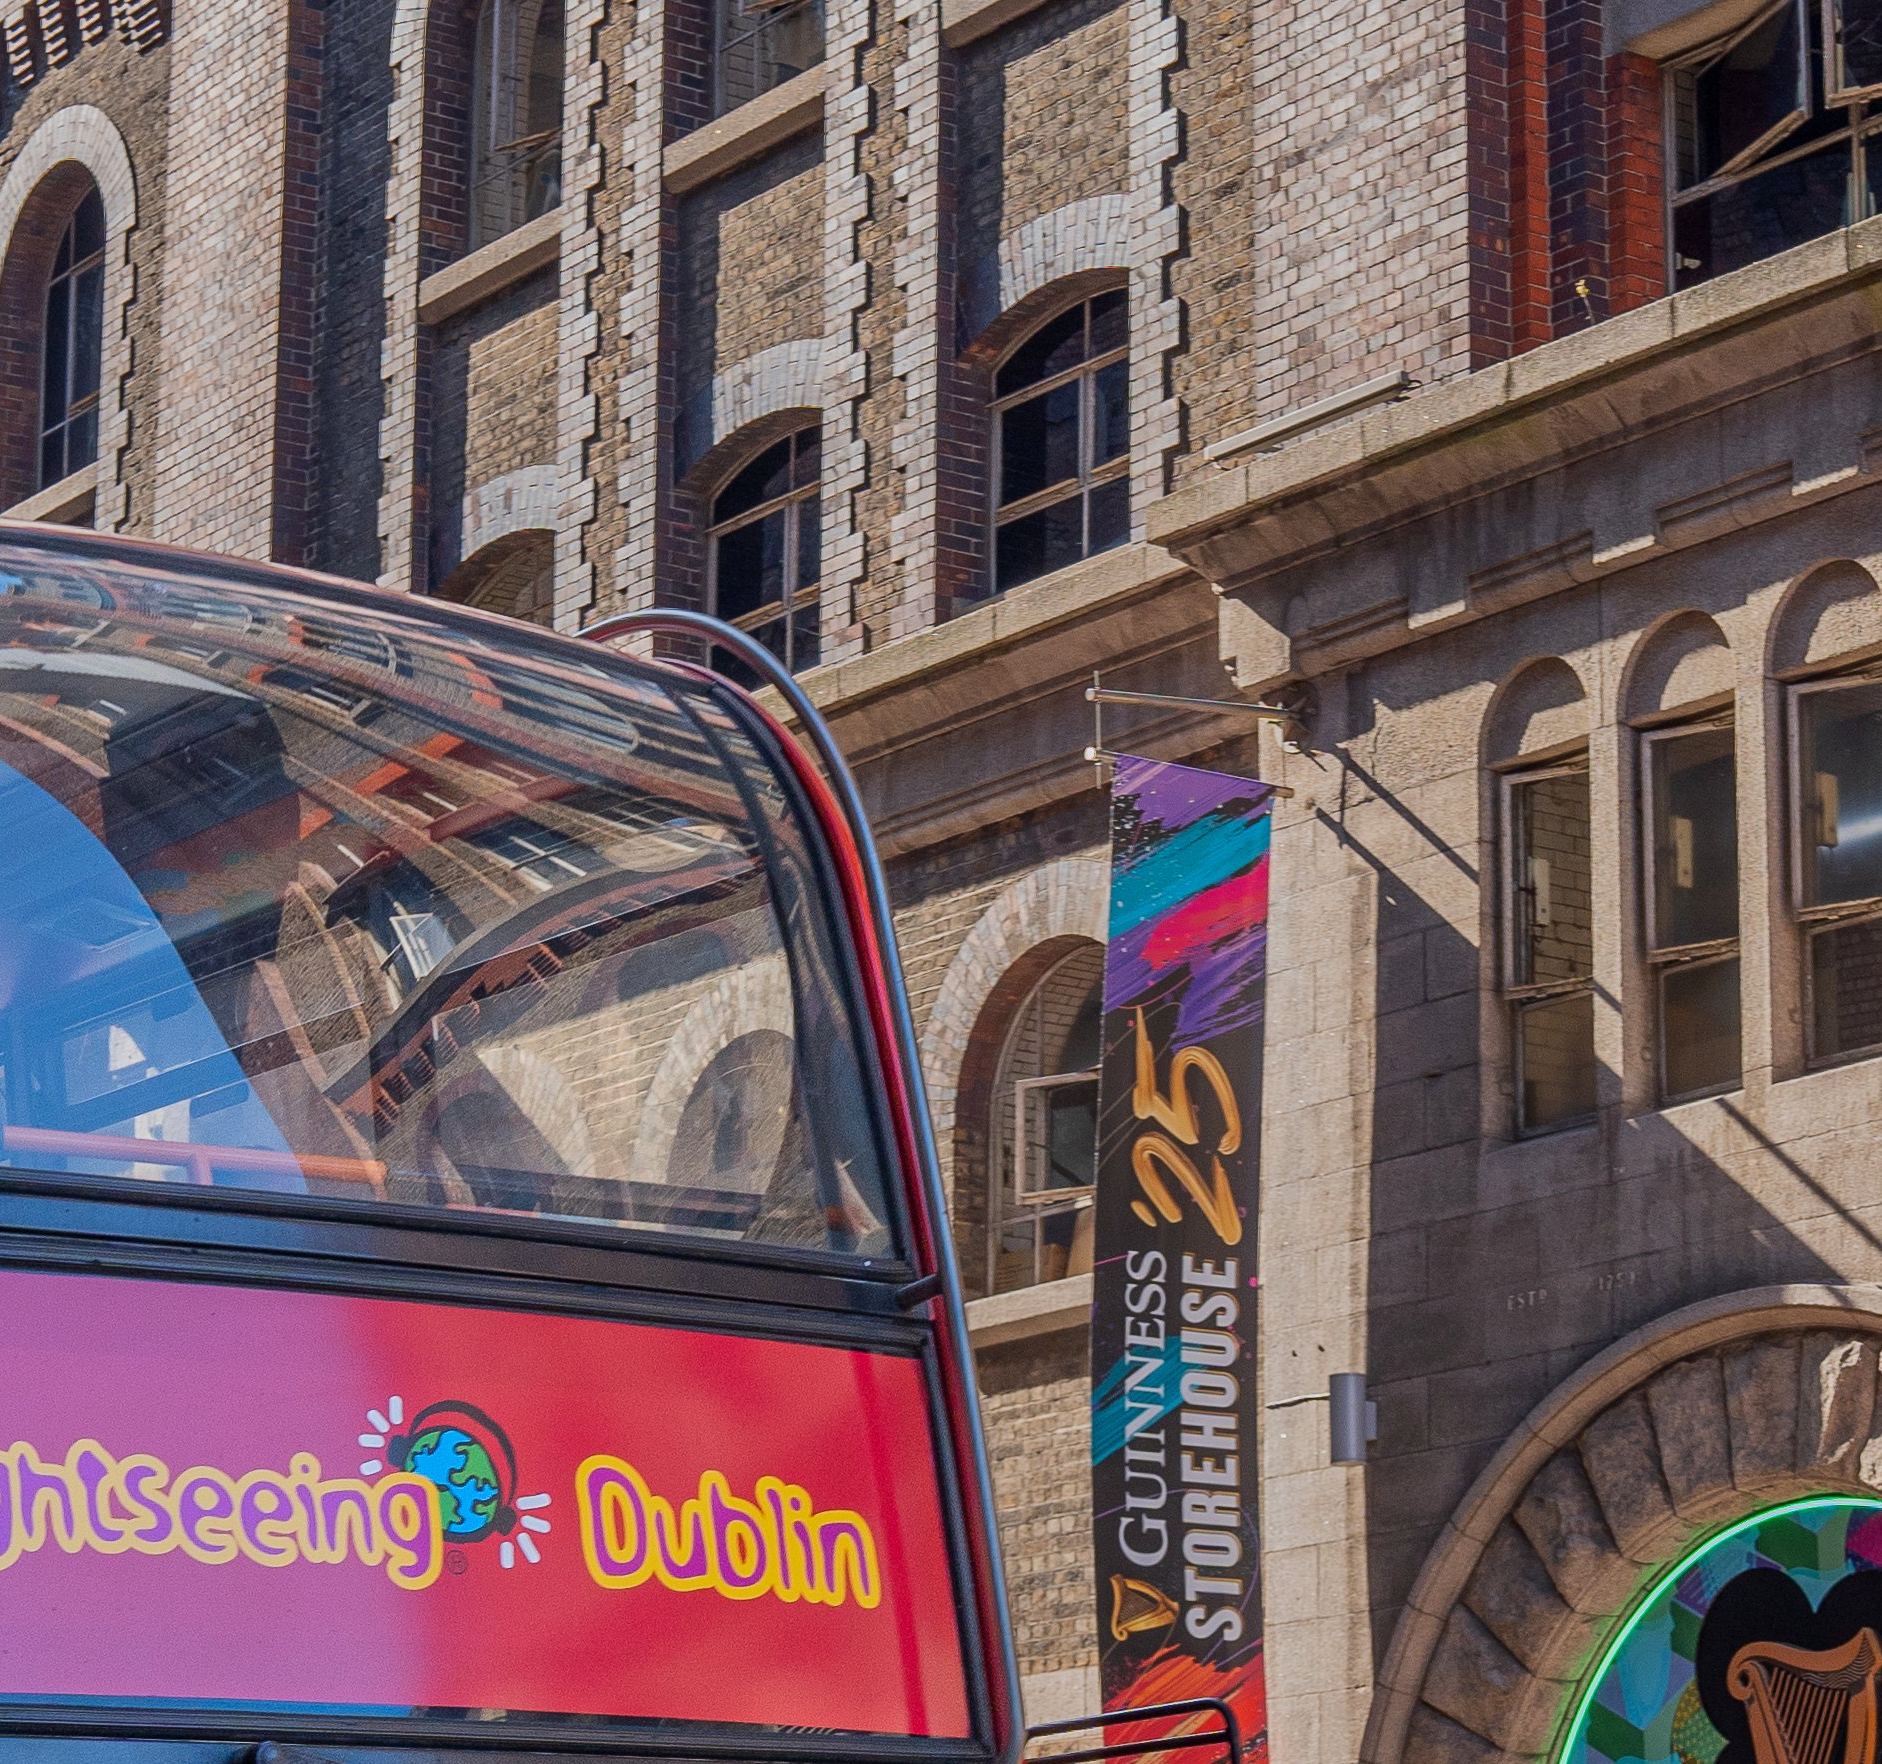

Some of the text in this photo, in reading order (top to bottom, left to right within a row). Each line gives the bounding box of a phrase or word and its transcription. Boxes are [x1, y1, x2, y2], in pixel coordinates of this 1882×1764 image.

[575, 1453, 882, 1608] Dublin
[1119, 1247, 1170, 1569] GUINNESS
[1182, 1252, 1244, 1647] STOREHOUSE
